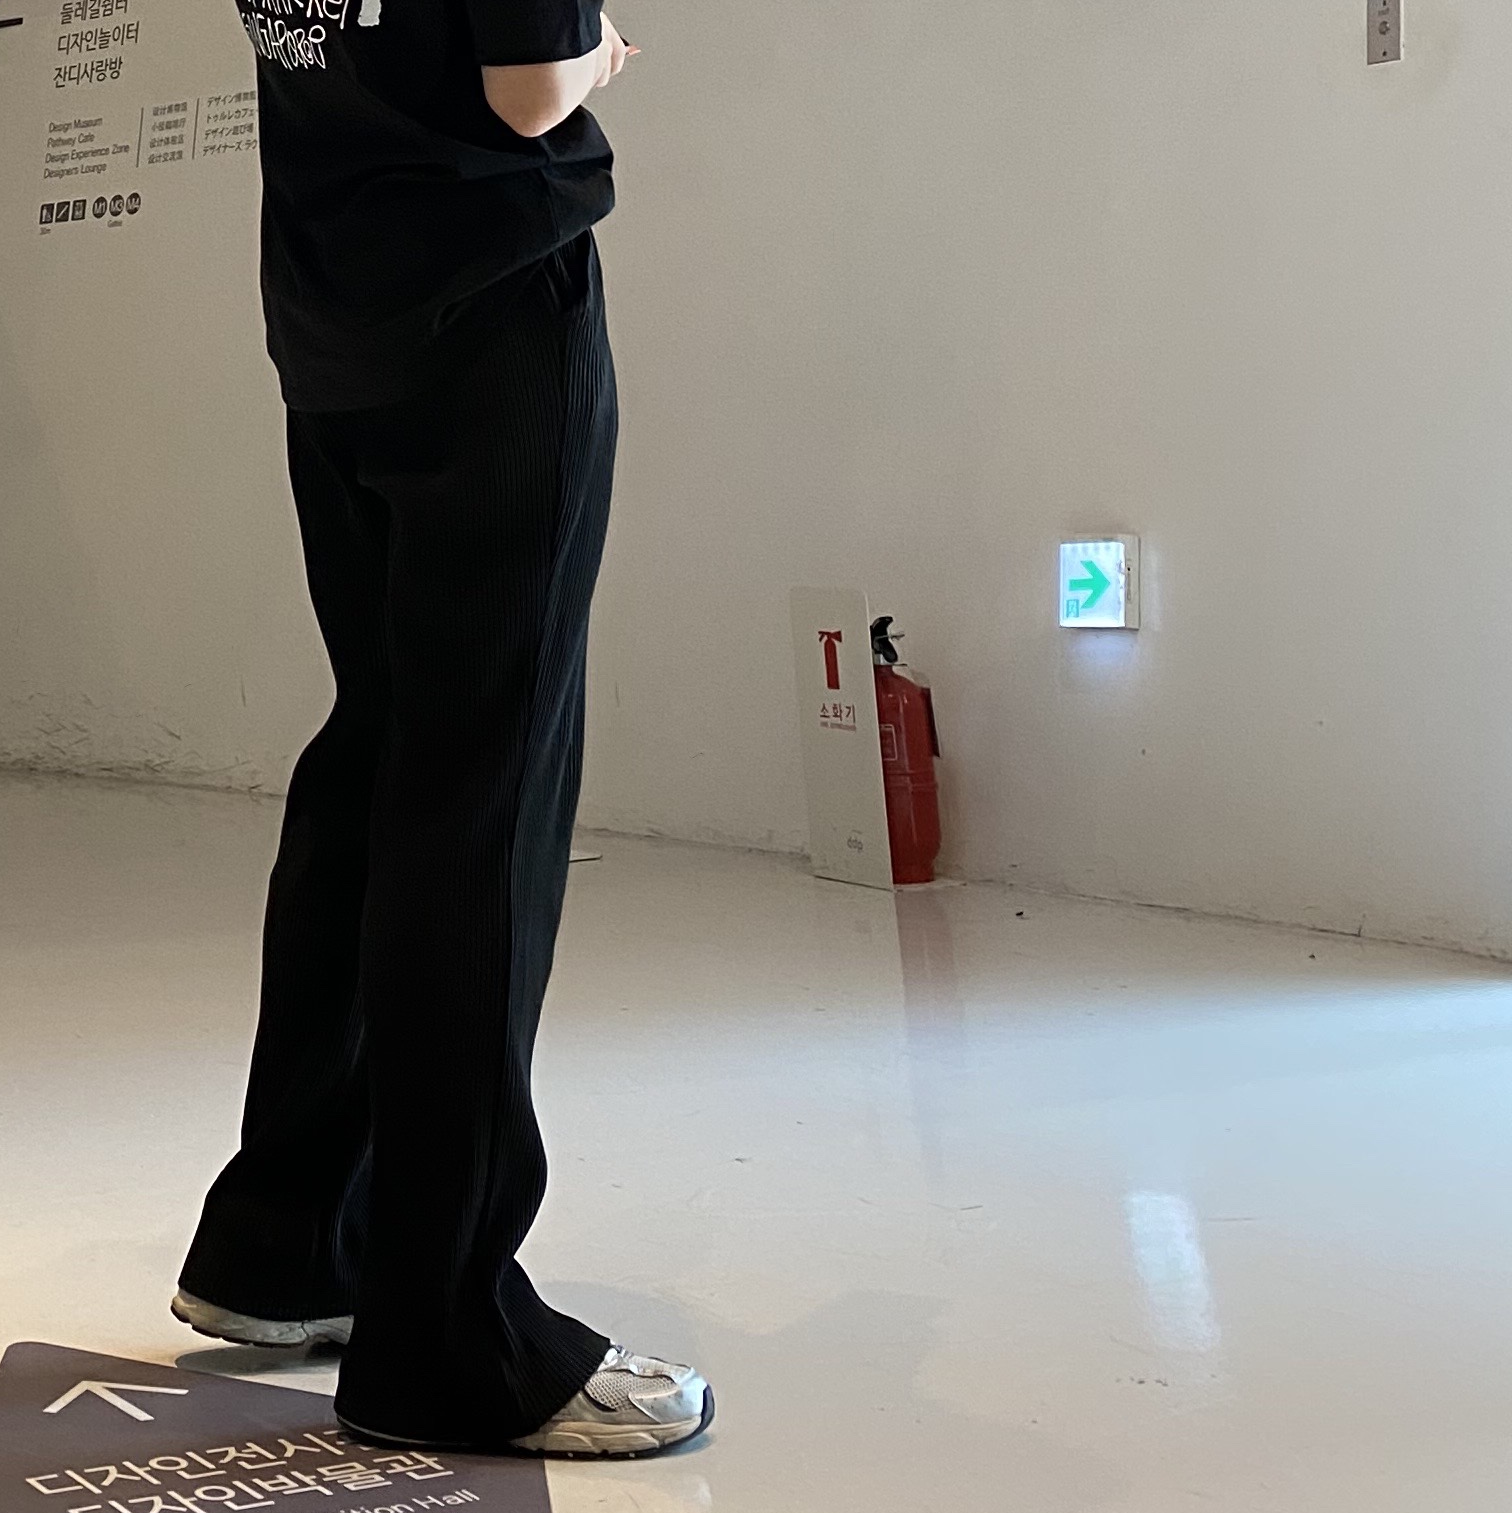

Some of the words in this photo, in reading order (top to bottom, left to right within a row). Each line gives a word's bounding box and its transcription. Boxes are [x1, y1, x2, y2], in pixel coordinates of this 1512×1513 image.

[57, 21, 140, 55] 디자인놀이터
[53, 56, 123, 88] 잔디사랑방
[49, 122, 72, 134] Design
[45, 153, 69, 164] Design
[112, 144, 130, 154] Zone
[81, 163, 107, 175] Lounge
[819, 702, 856, 724] 소화기
[25, 1430, 372, 1495] 디자인전시
[411, 1489, 480, 1510] Hall
